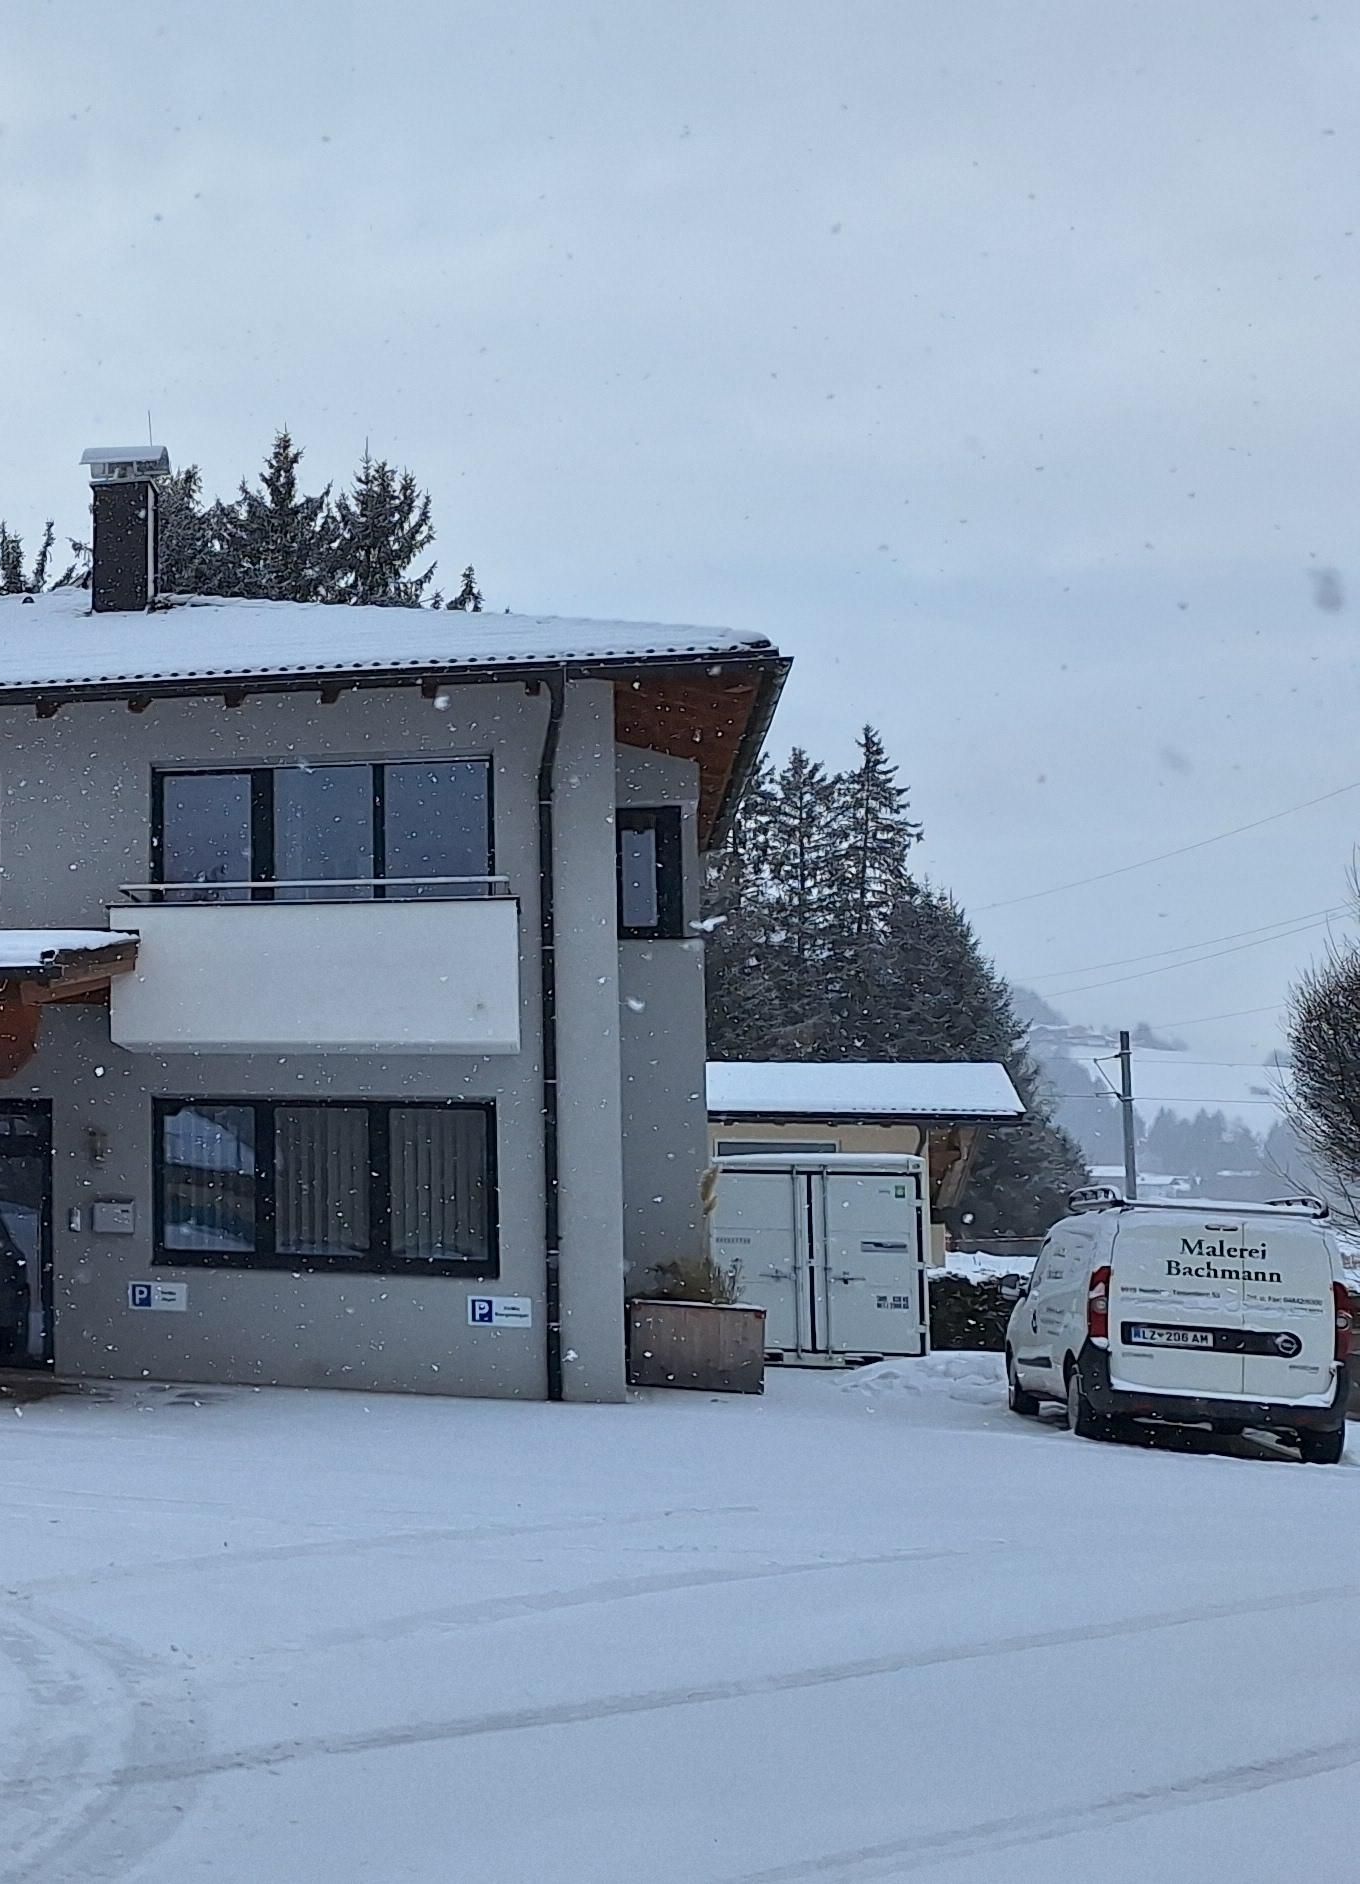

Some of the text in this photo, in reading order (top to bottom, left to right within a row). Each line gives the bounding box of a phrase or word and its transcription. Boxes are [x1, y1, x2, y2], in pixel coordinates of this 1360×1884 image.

[1180, 1237, 1267, 1260] Malerei
[1166, 1259, 1283, 1284] Bachmann
[135, 1286, 148, 1305] P
[475, 1301, 490, 1321] P
